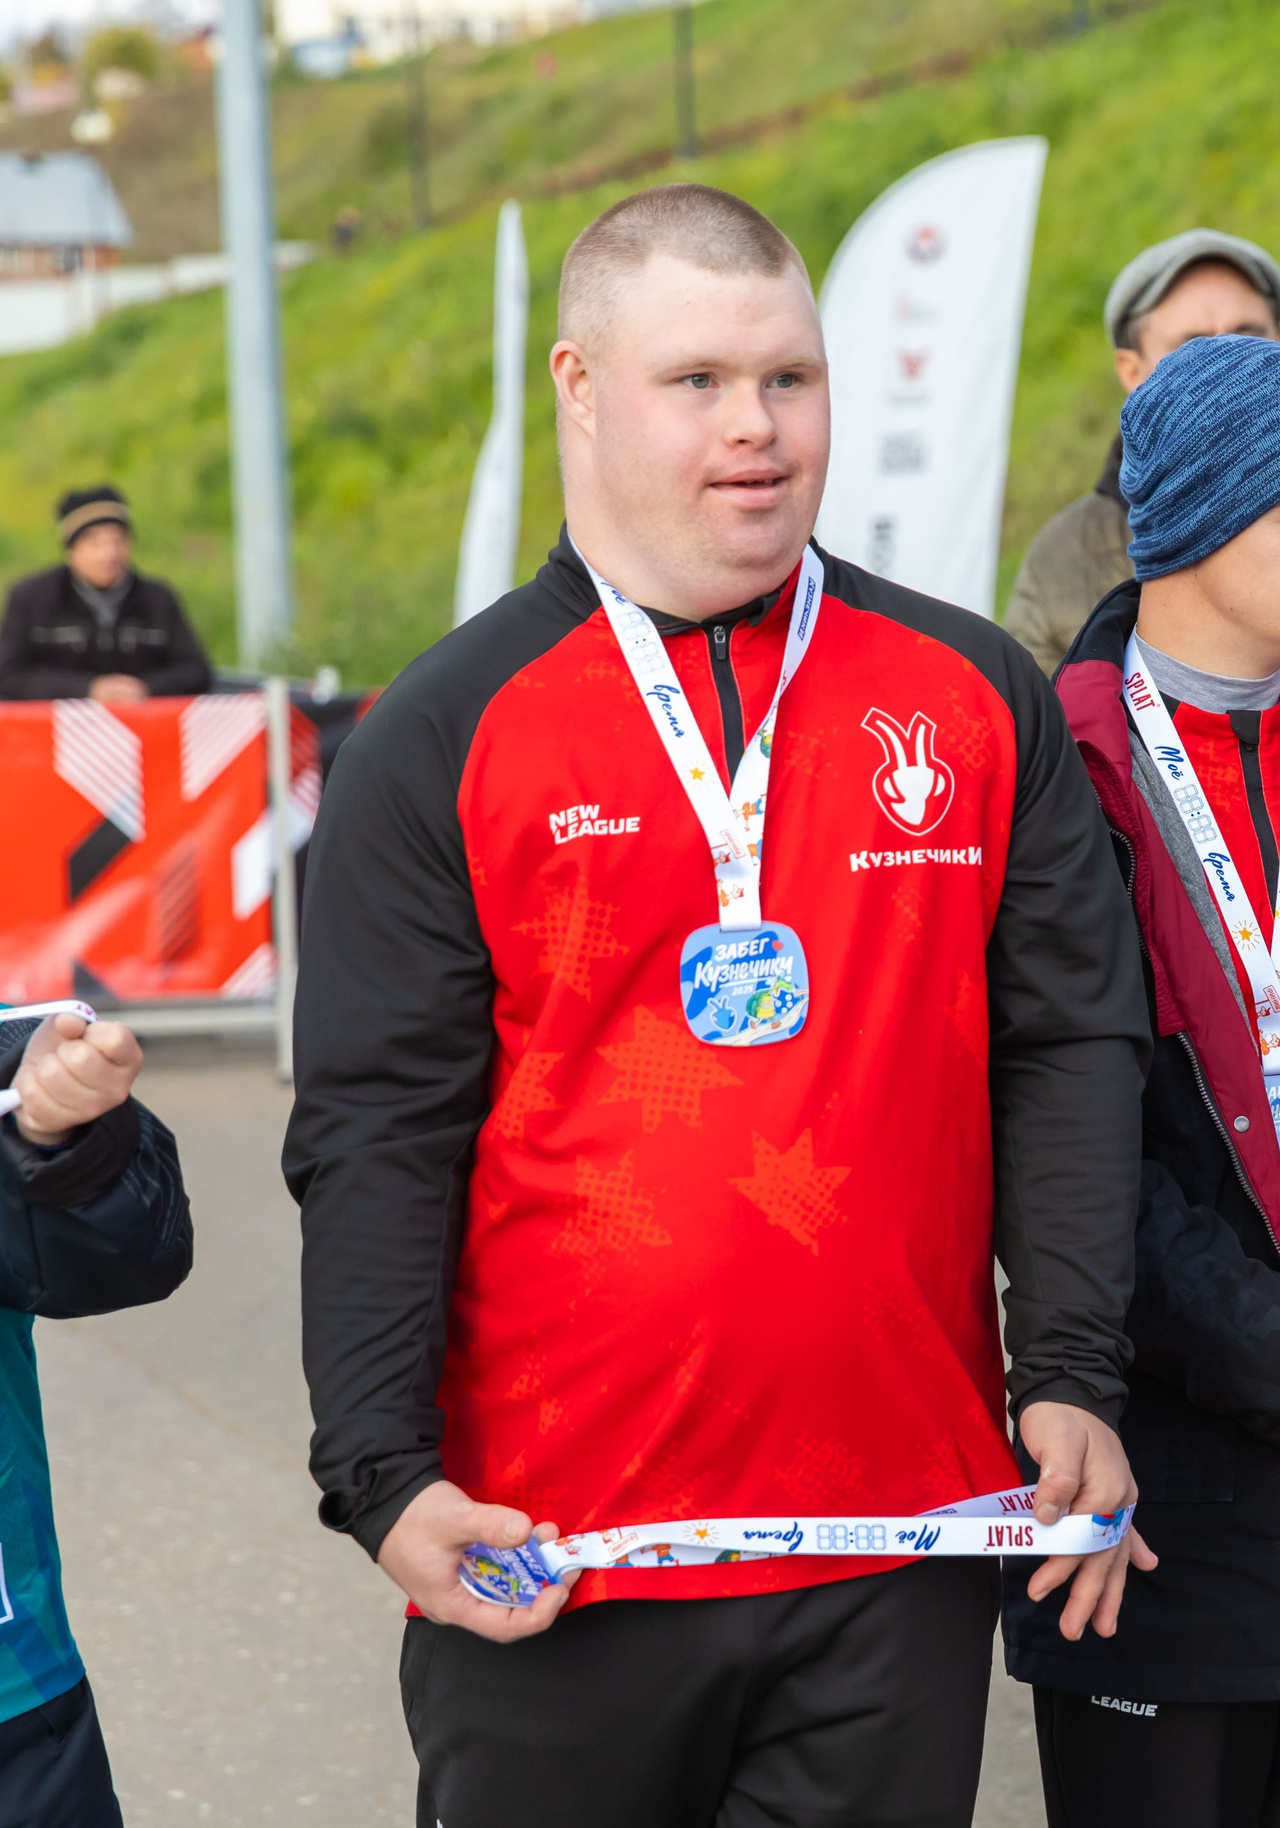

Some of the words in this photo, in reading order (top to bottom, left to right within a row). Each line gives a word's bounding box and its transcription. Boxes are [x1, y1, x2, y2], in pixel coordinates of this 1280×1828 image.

[1125, 672, 1155, 711] SPLAT
[550, 804, 600, 829] NEW
[552, 816, 641, 845] LEAGUE
[714, 937, 770, 962] ЗАБЕГ
[986, 1525, 1034, 1547] SPLAT
[1090, 1695, 1158, 1717] LEAGUE
